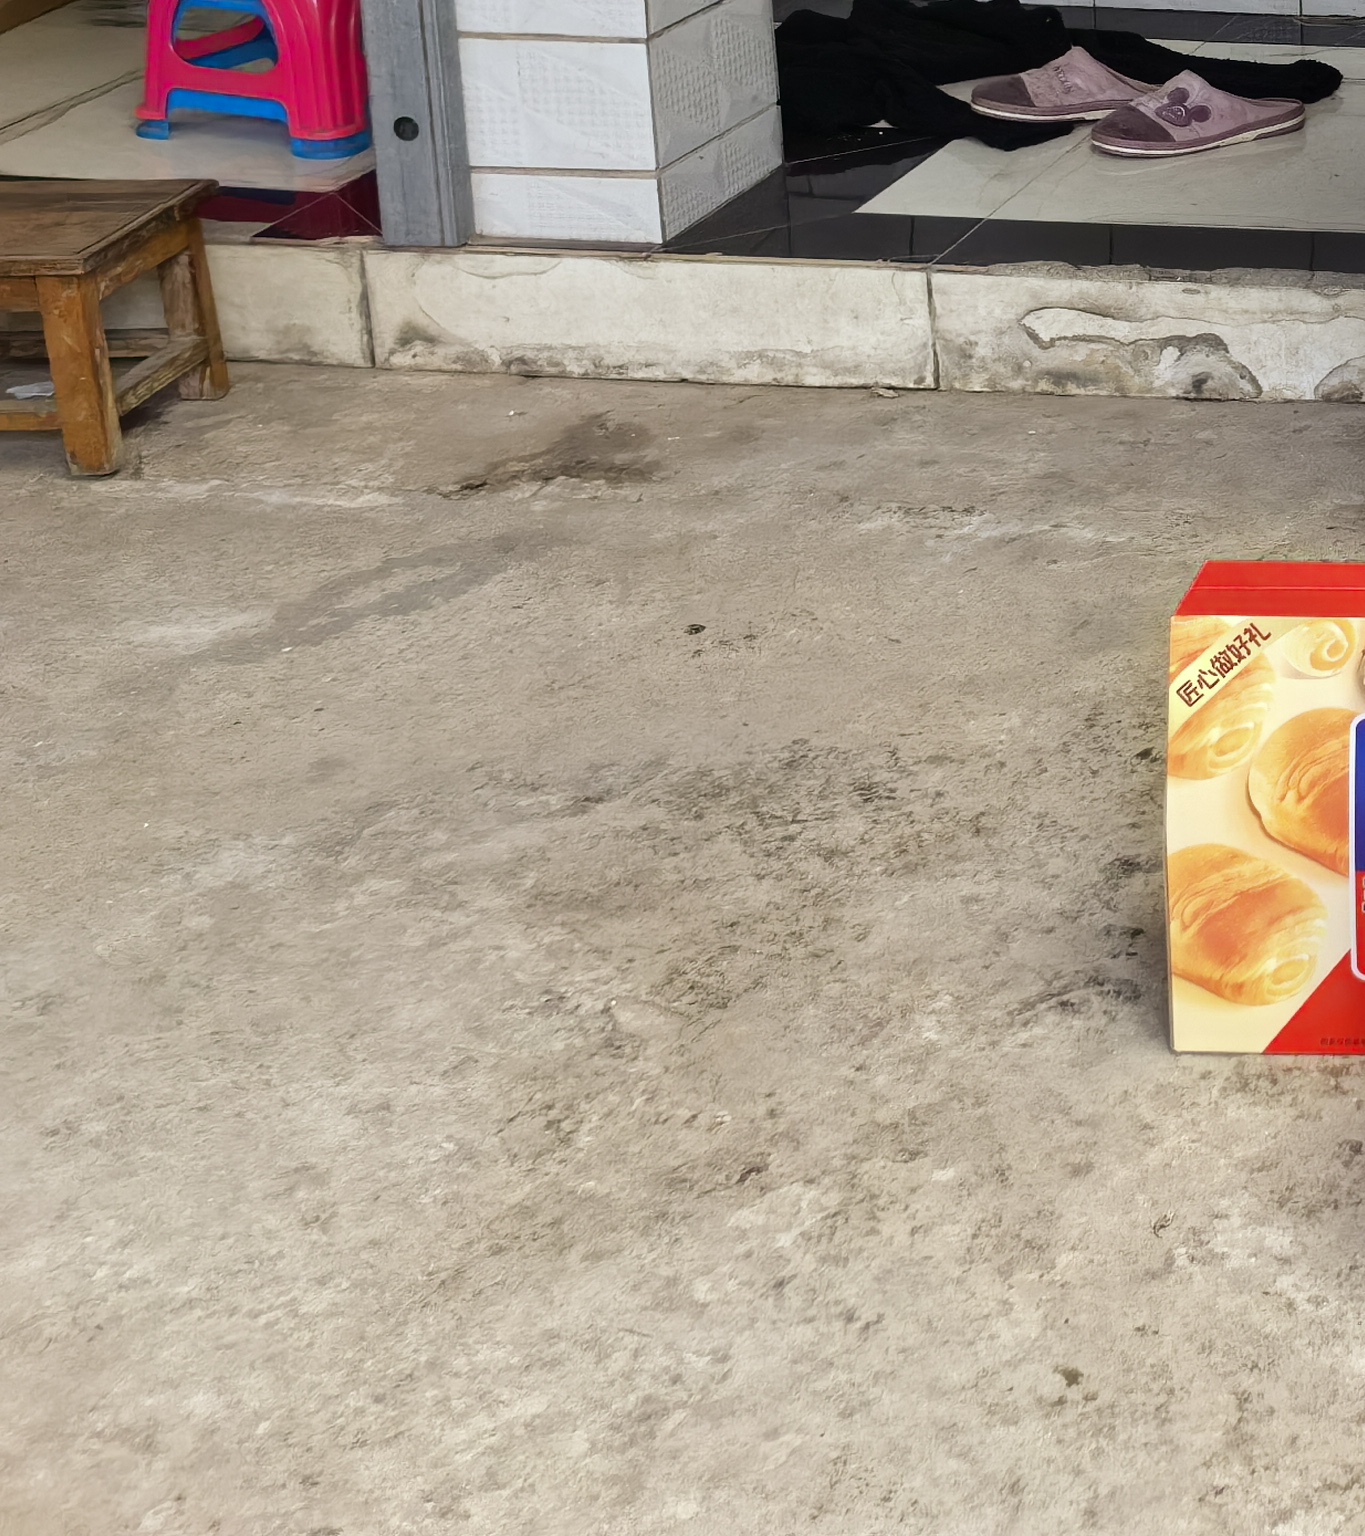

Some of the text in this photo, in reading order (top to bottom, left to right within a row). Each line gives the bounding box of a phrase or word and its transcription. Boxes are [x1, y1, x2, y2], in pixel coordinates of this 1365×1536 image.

[1176, 622, 1272, 708] 匠心做好礼
